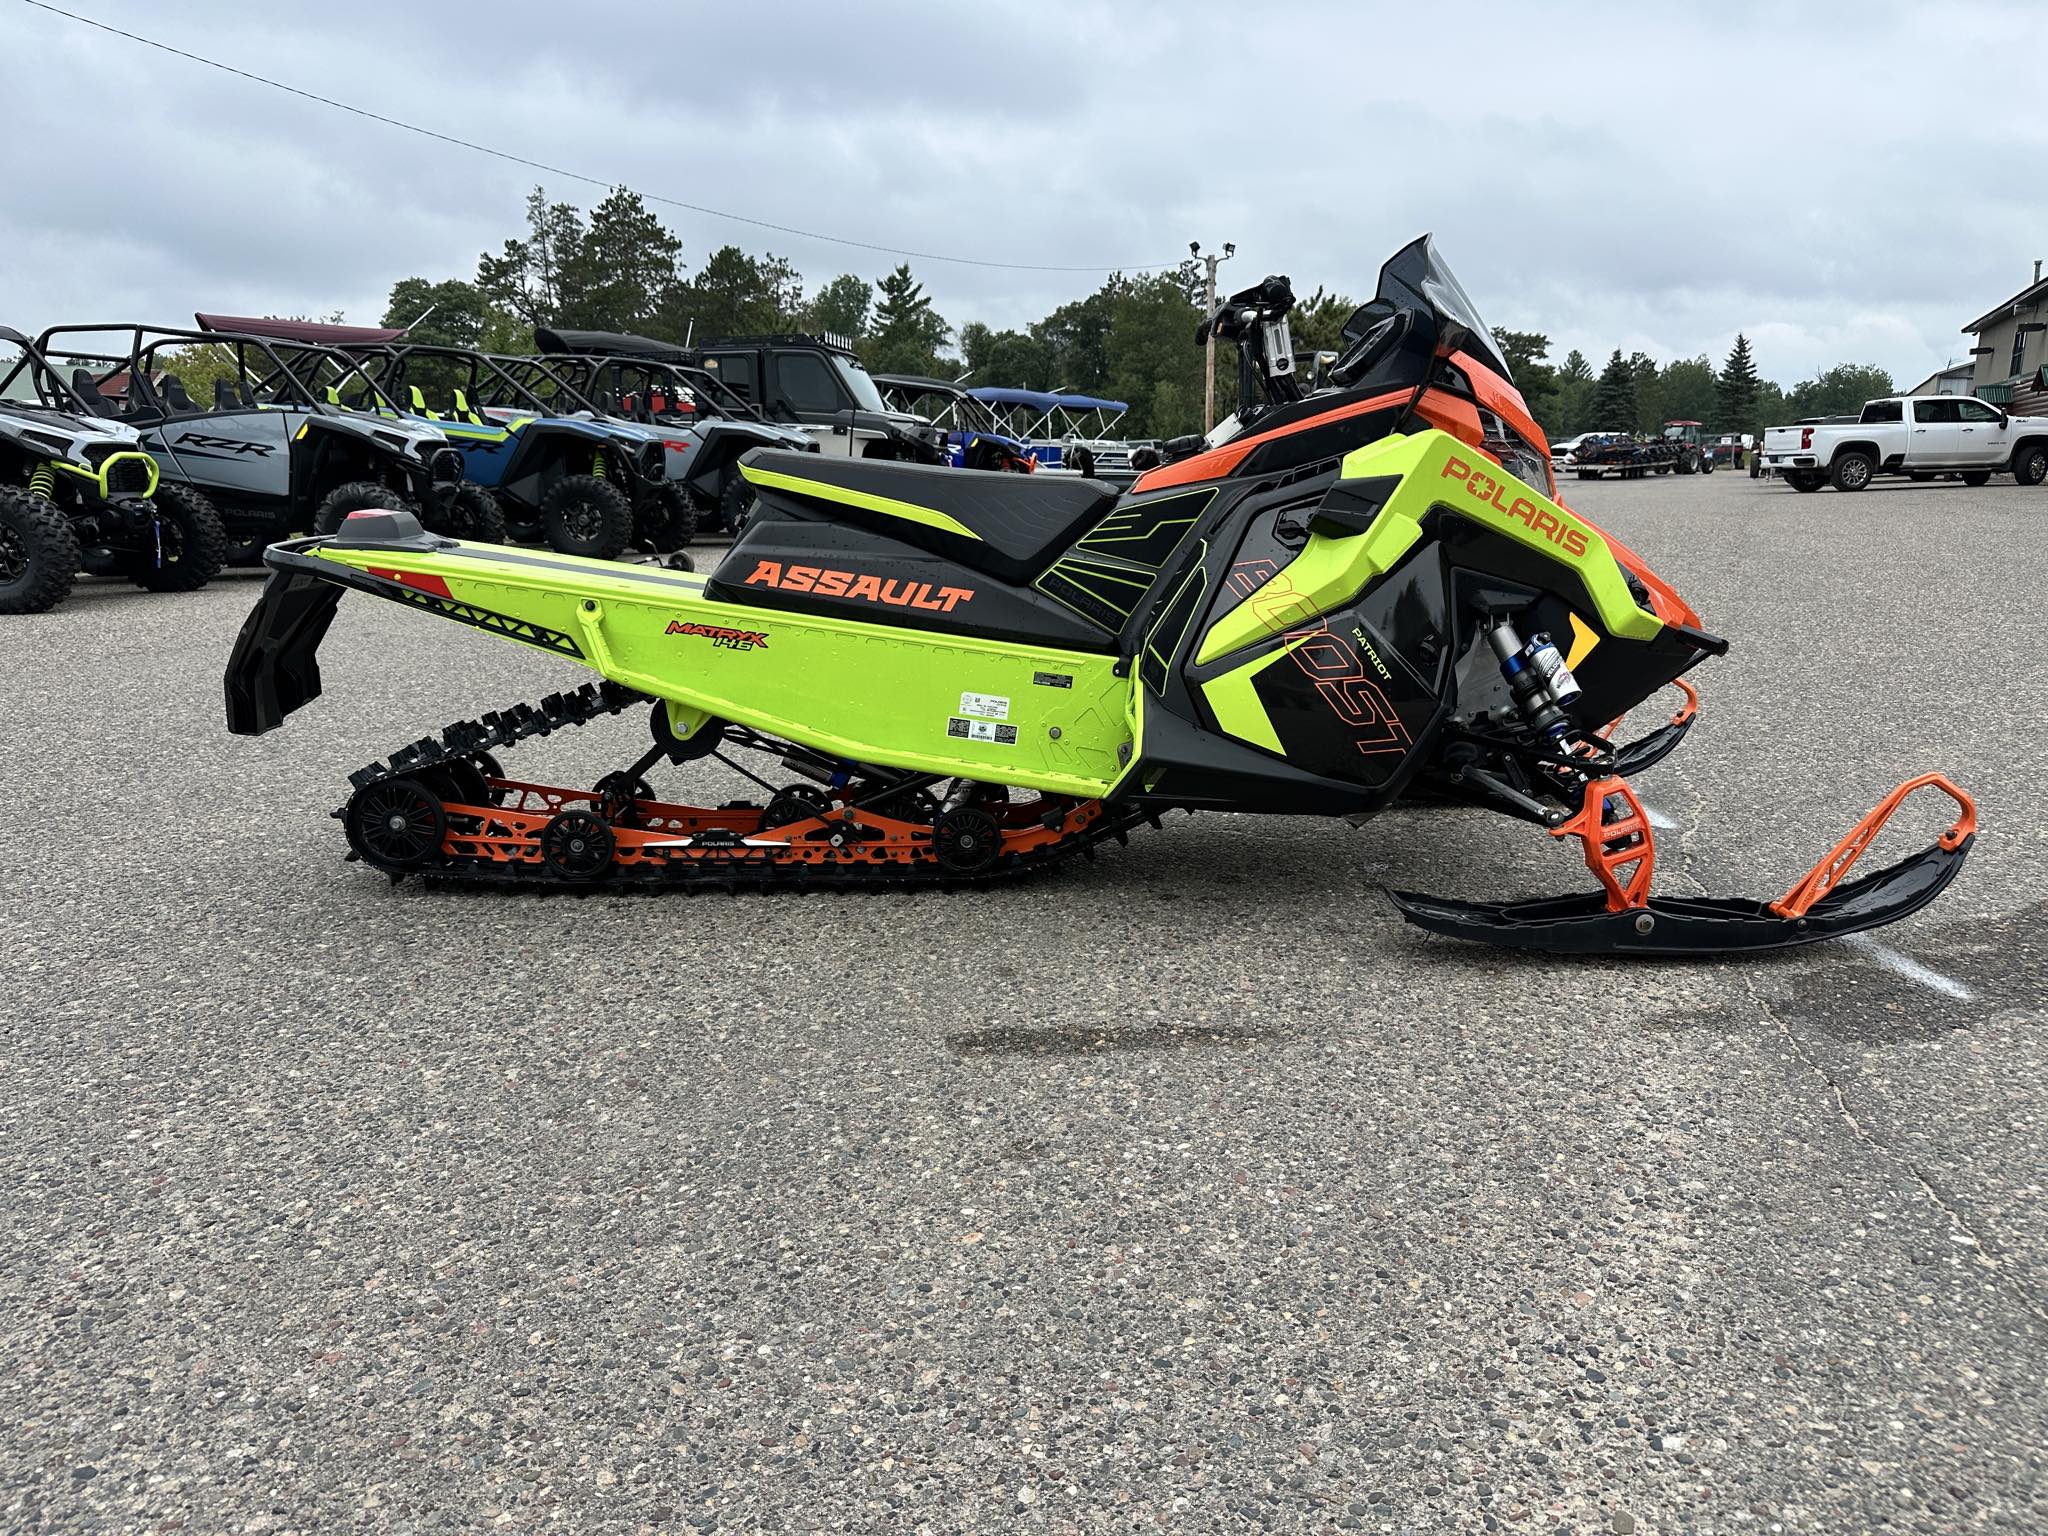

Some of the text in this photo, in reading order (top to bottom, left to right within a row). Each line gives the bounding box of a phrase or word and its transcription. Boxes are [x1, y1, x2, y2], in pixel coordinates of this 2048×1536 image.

[174, 432, 276, 458] RZR
[224, 508, 276, 519] POLARIS
[1441, 455, 1589, 557] POLARIS
[744, 560, 975, 612] ASSAULT
[1048, 577, 1118, 626] POLARIS
[665, 620, 769, 648] MATRYX
[713, 636, 755, 651] 146
[1225, 558, 1414, 755] BOOST
[1352, 627, 1392, 681] PATRIOT
